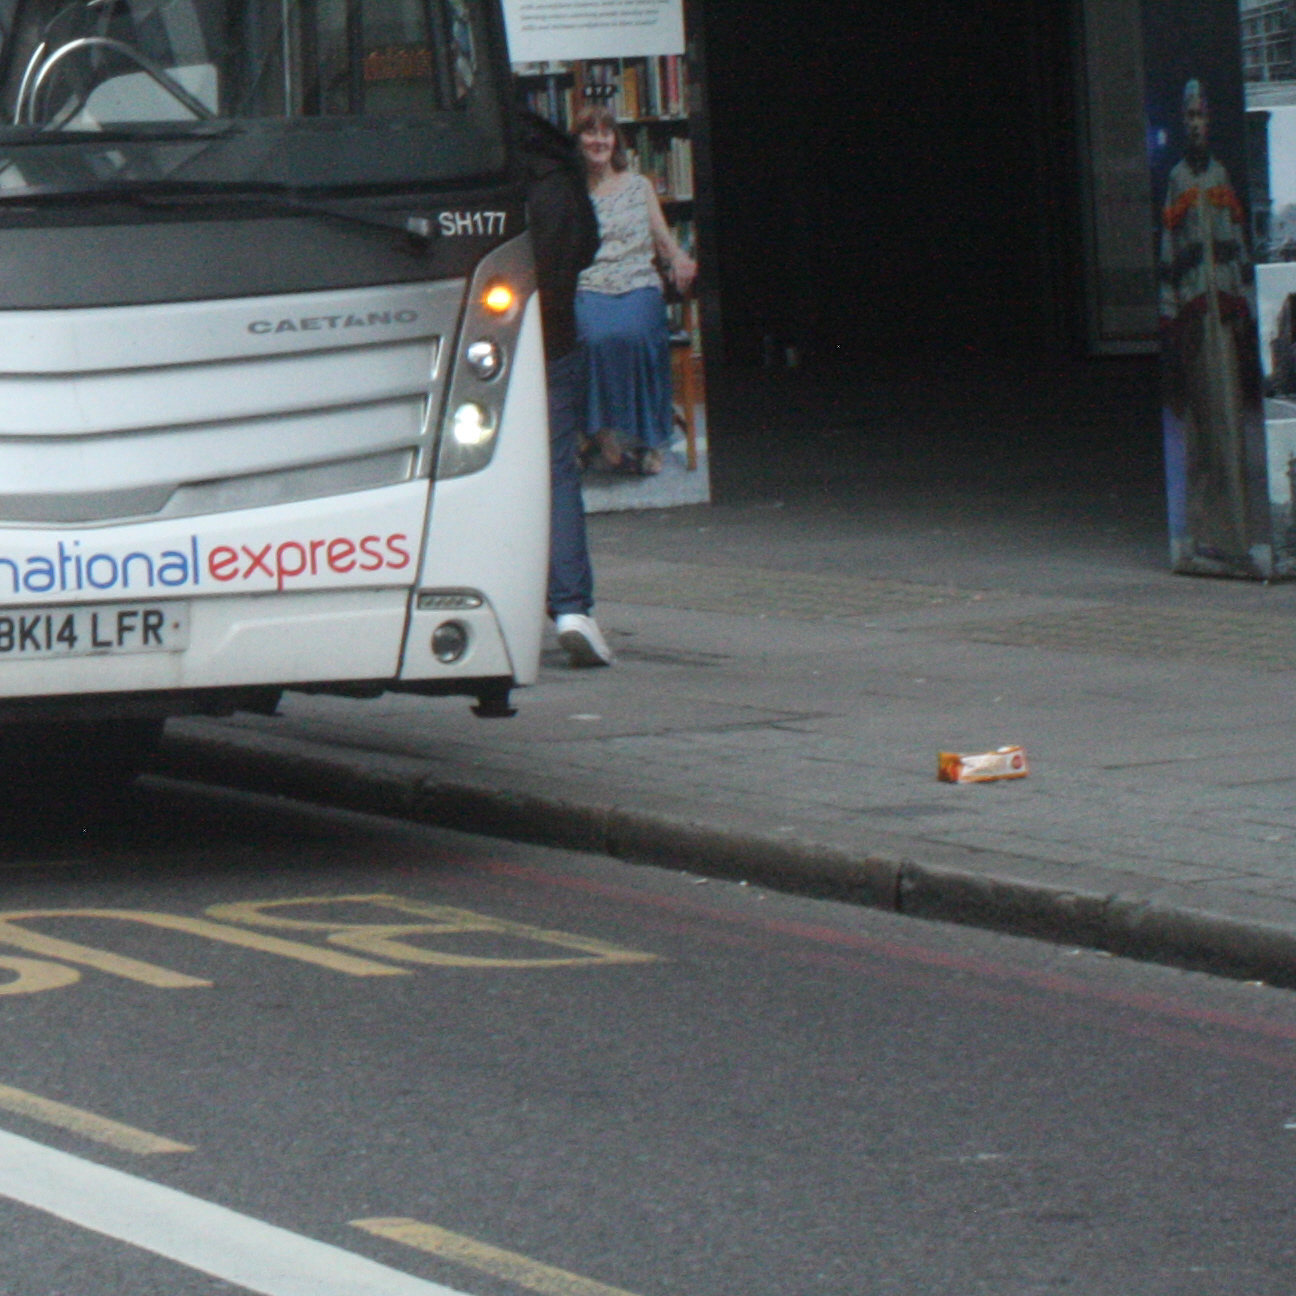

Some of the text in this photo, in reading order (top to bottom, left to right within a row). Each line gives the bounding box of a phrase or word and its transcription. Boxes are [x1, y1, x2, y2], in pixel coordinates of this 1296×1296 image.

[438, 210, 507, 236] SH177
[246, 309, 419, 335] CAETANO
[207, 532, 411, 591] express
[90, 609, 165, 649] LFR
